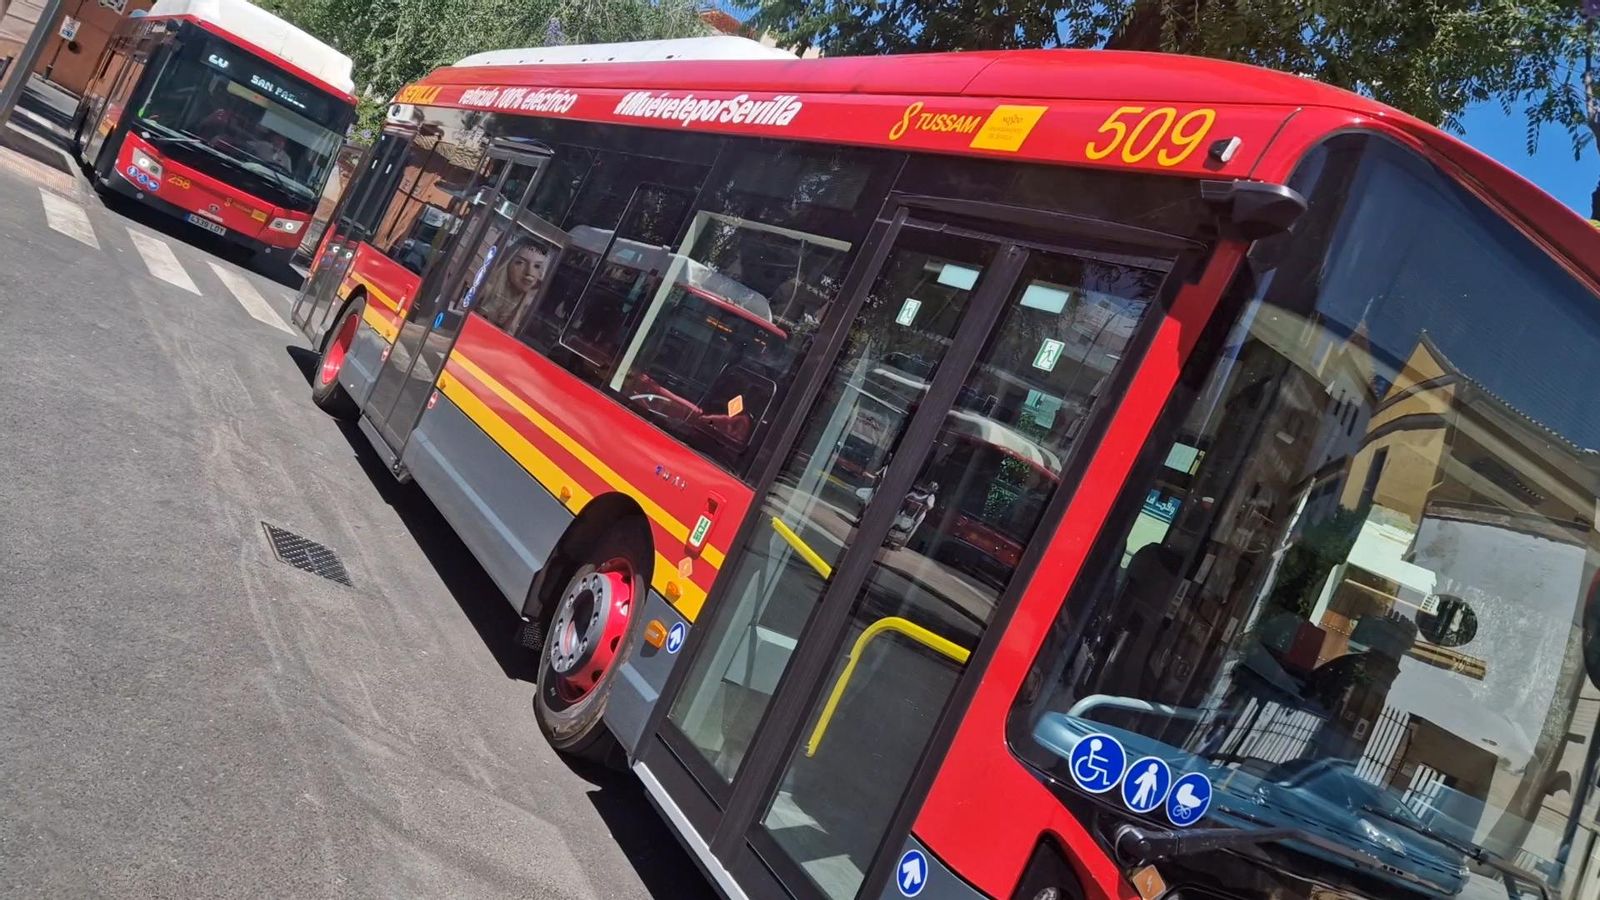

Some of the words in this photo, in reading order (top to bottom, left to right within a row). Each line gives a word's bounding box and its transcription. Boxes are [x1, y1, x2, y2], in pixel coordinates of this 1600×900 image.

[250, 74, 274, 92] SAN
[400, 85, 443, 105] SEVILLA
[494, 86, 529, 109] 100%
[523, 87, 578, 113] eléctrico
[613, 91, 803, 127] #MuéveteporSevilla
[915, 111, 982, 134] TUSSAM
[1085, 106, 1217, 166] 509
[167, 174, 191, 190] 258
